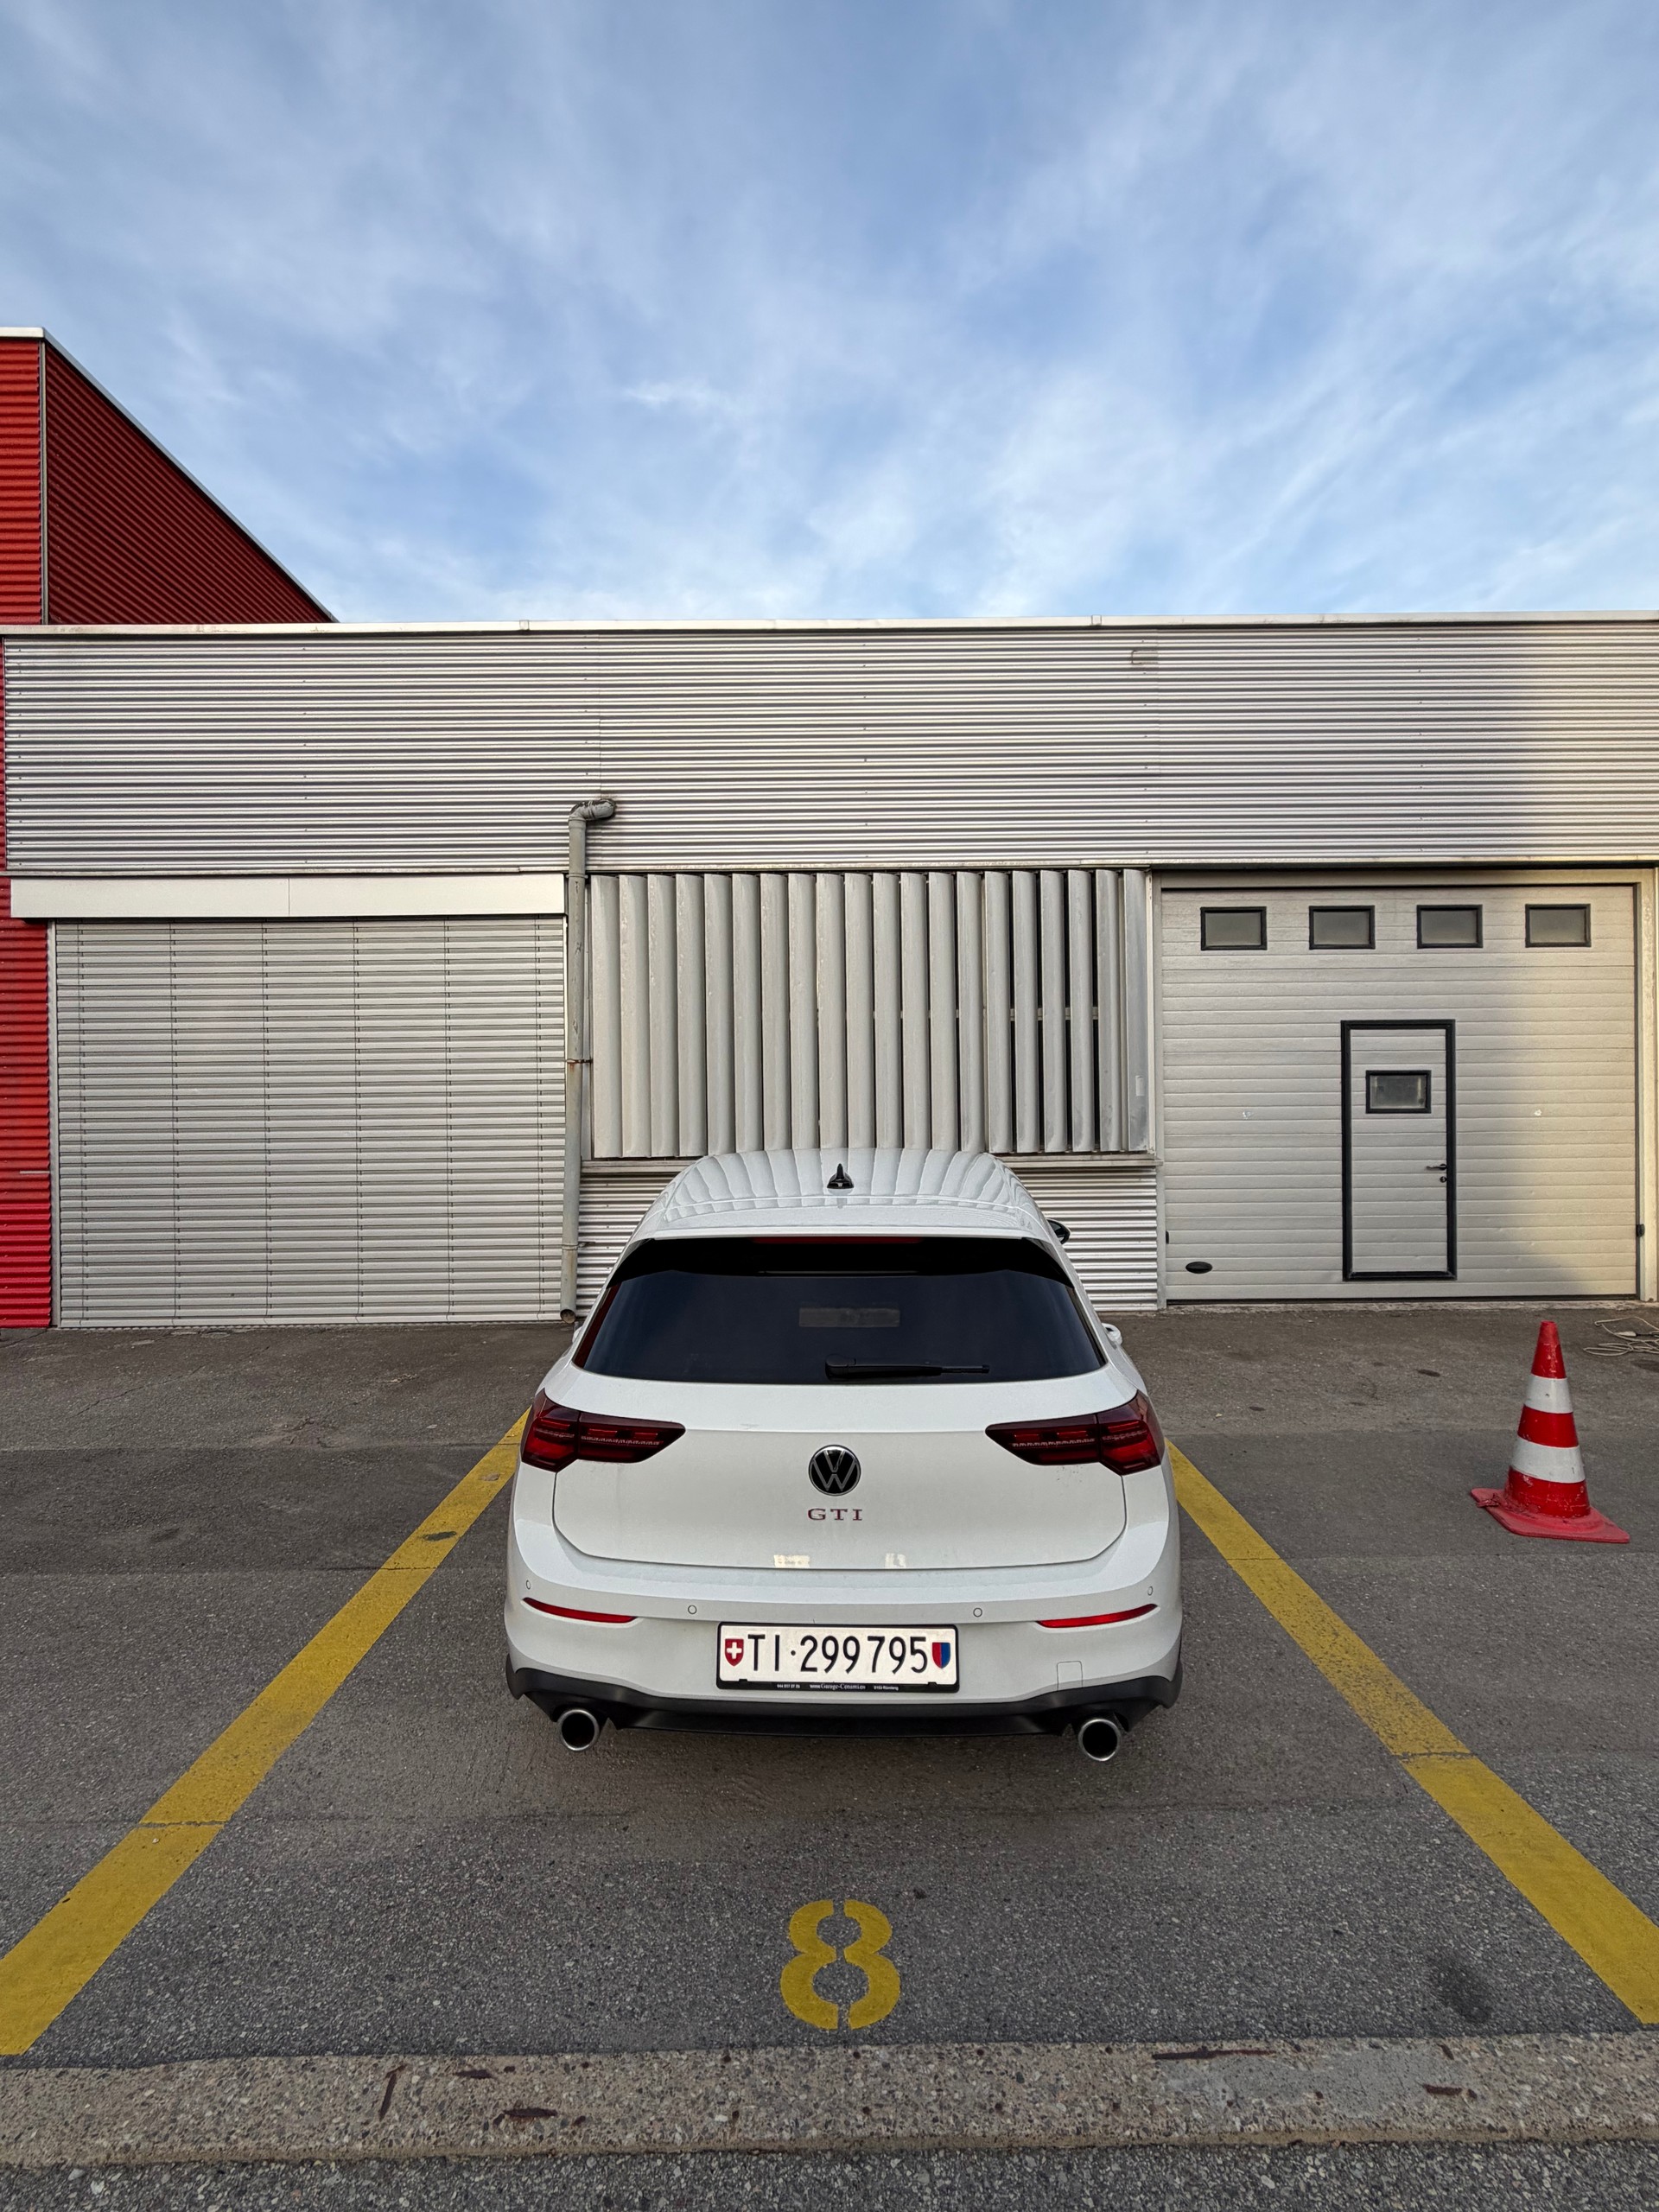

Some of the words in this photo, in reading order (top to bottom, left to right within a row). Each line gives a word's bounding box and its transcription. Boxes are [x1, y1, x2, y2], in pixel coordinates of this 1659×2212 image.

[810, 1448, 859, 1493] VW
[807, 1508, 863, 1522] GTI
[780, 1899, 901, 2030] 8
